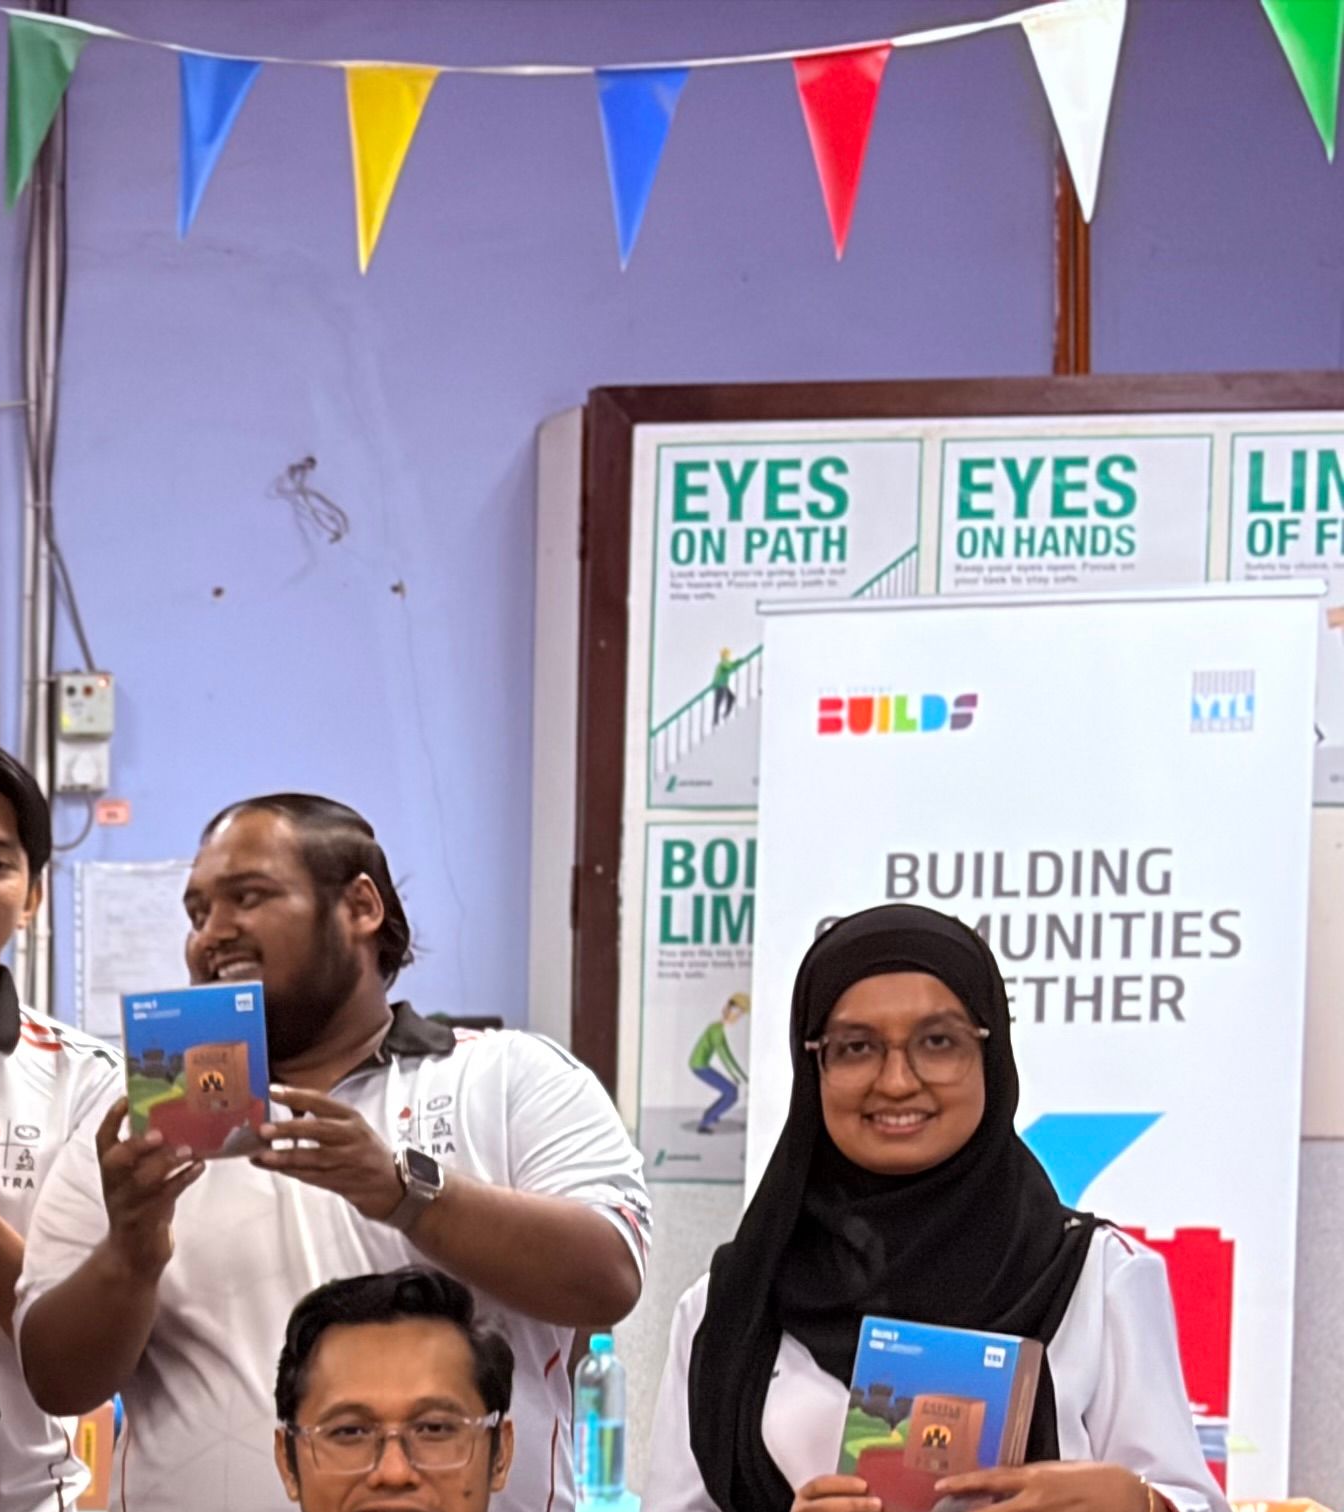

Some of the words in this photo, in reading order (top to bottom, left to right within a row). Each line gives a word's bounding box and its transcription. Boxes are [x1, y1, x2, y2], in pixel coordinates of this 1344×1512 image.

[672, 455, 849, 522] EYES
[956, 454, 1138, 520] EYES
[671, 528, 727, 565] ON
[744, 525, 848, 564] PATH
[956, 526, 1004, 559] ON
[1014, 523, 1137, 558] HANDS
[1247, 519, 1301, 557] OF
[1315, 518, 1344, 556] F
[818, 693, 978, 735] BUILDS
[884, 847, 1173, 900] BUILDING
